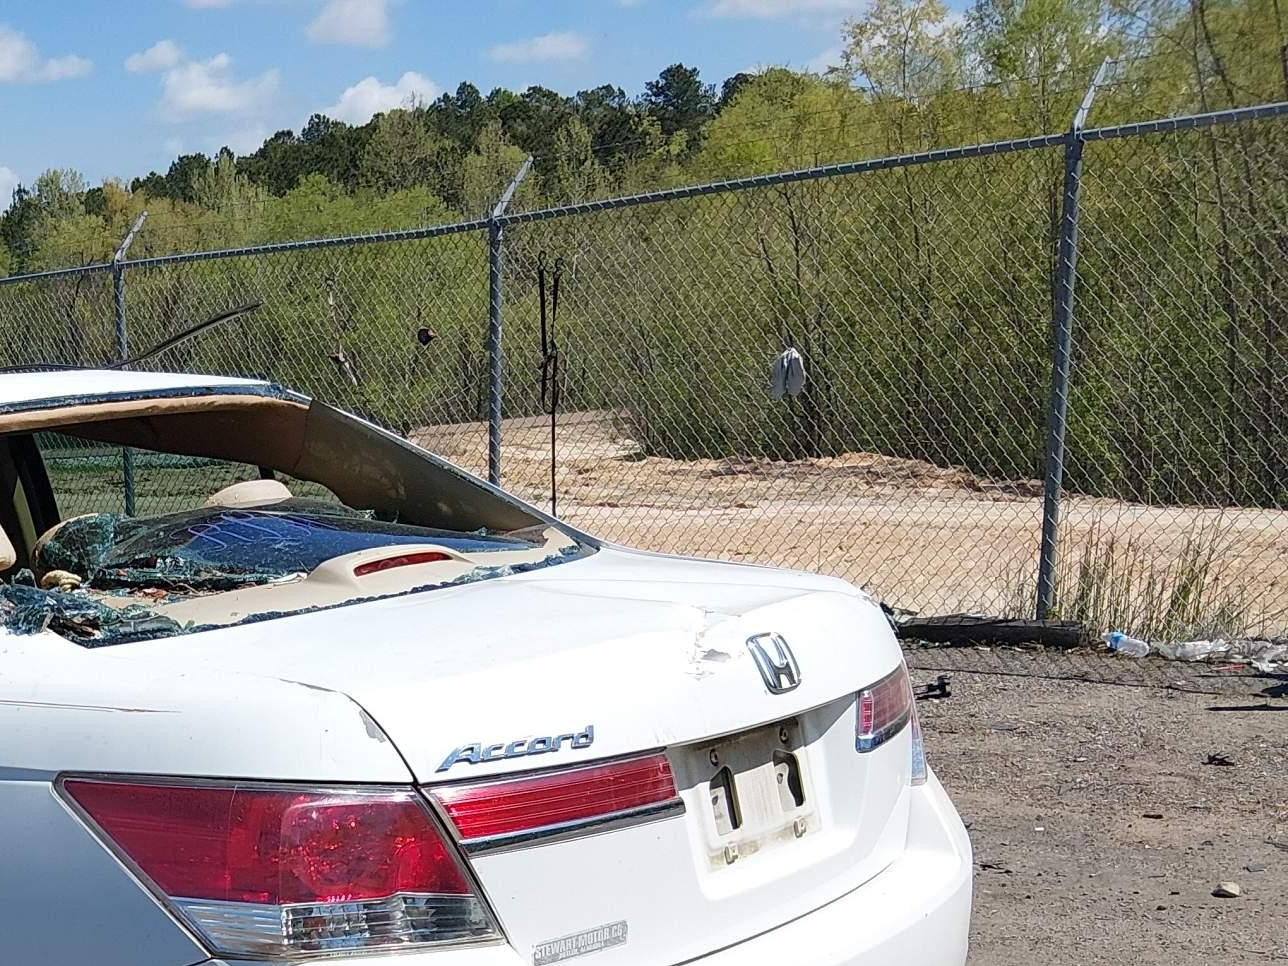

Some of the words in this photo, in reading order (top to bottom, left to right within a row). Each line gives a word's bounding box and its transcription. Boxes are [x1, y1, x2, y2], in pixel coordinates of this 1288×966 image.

[434, 724, 594, 773] Accord
[534, 937, 577, 960] STEWART
[578, 927, 610, 948] MOTOR
